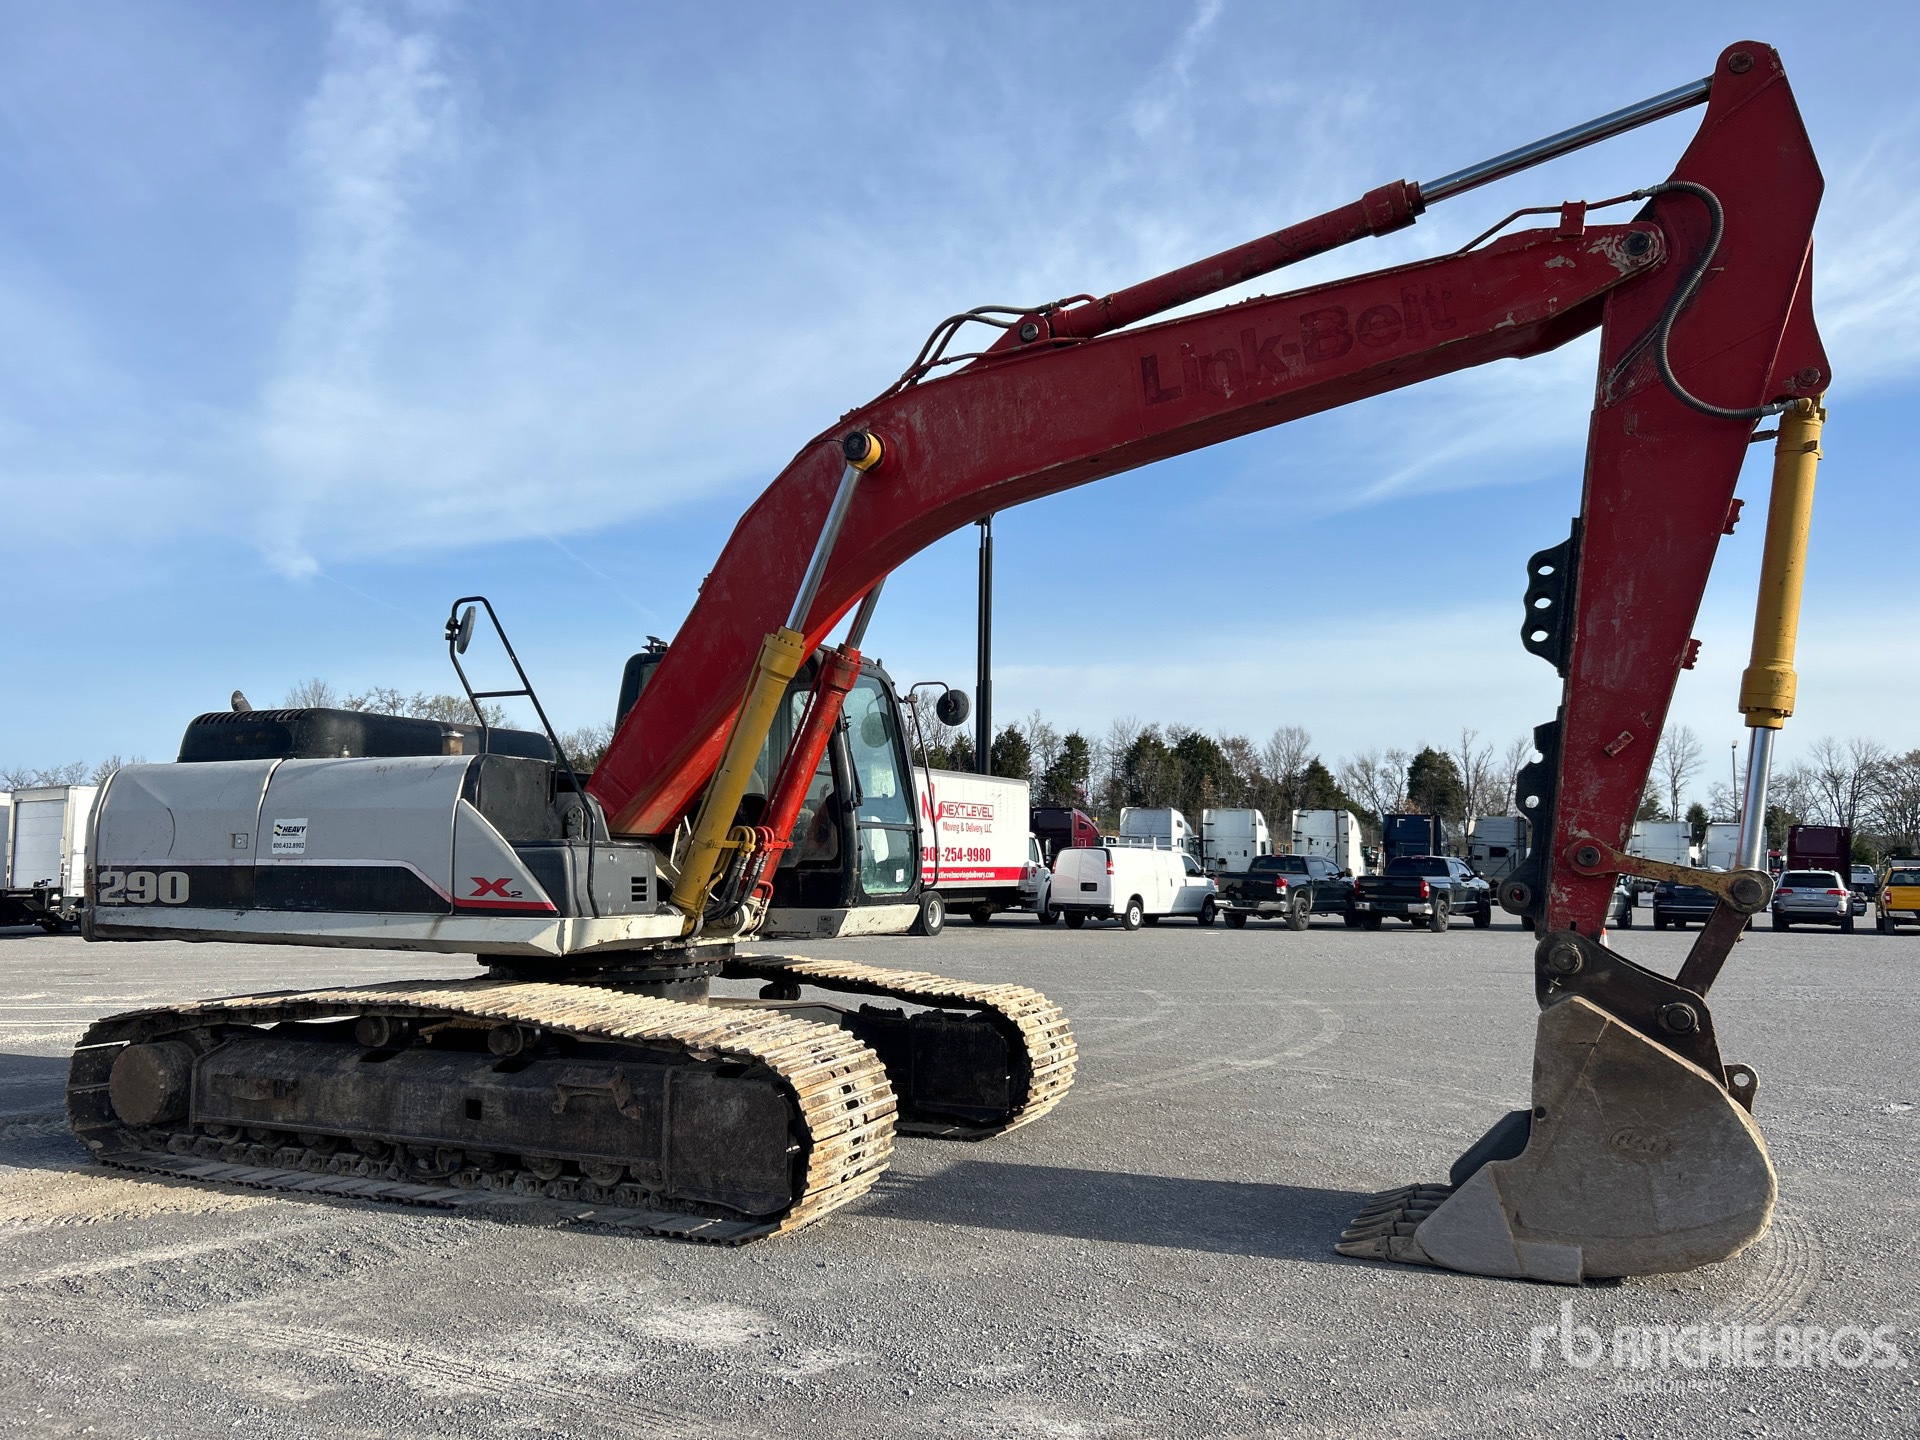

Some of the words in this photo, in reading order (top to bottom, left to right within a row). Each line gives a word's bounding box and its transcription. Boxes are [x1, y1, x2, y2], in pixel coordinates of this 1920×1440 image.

[1140, 281, 1457, 406] Link-Belt
[942, 821, 960, 834] Moving
[960, 822, 965, 831] &
[984, 823, 992, 833] LLC
[99, 871, 190, 904] 290
